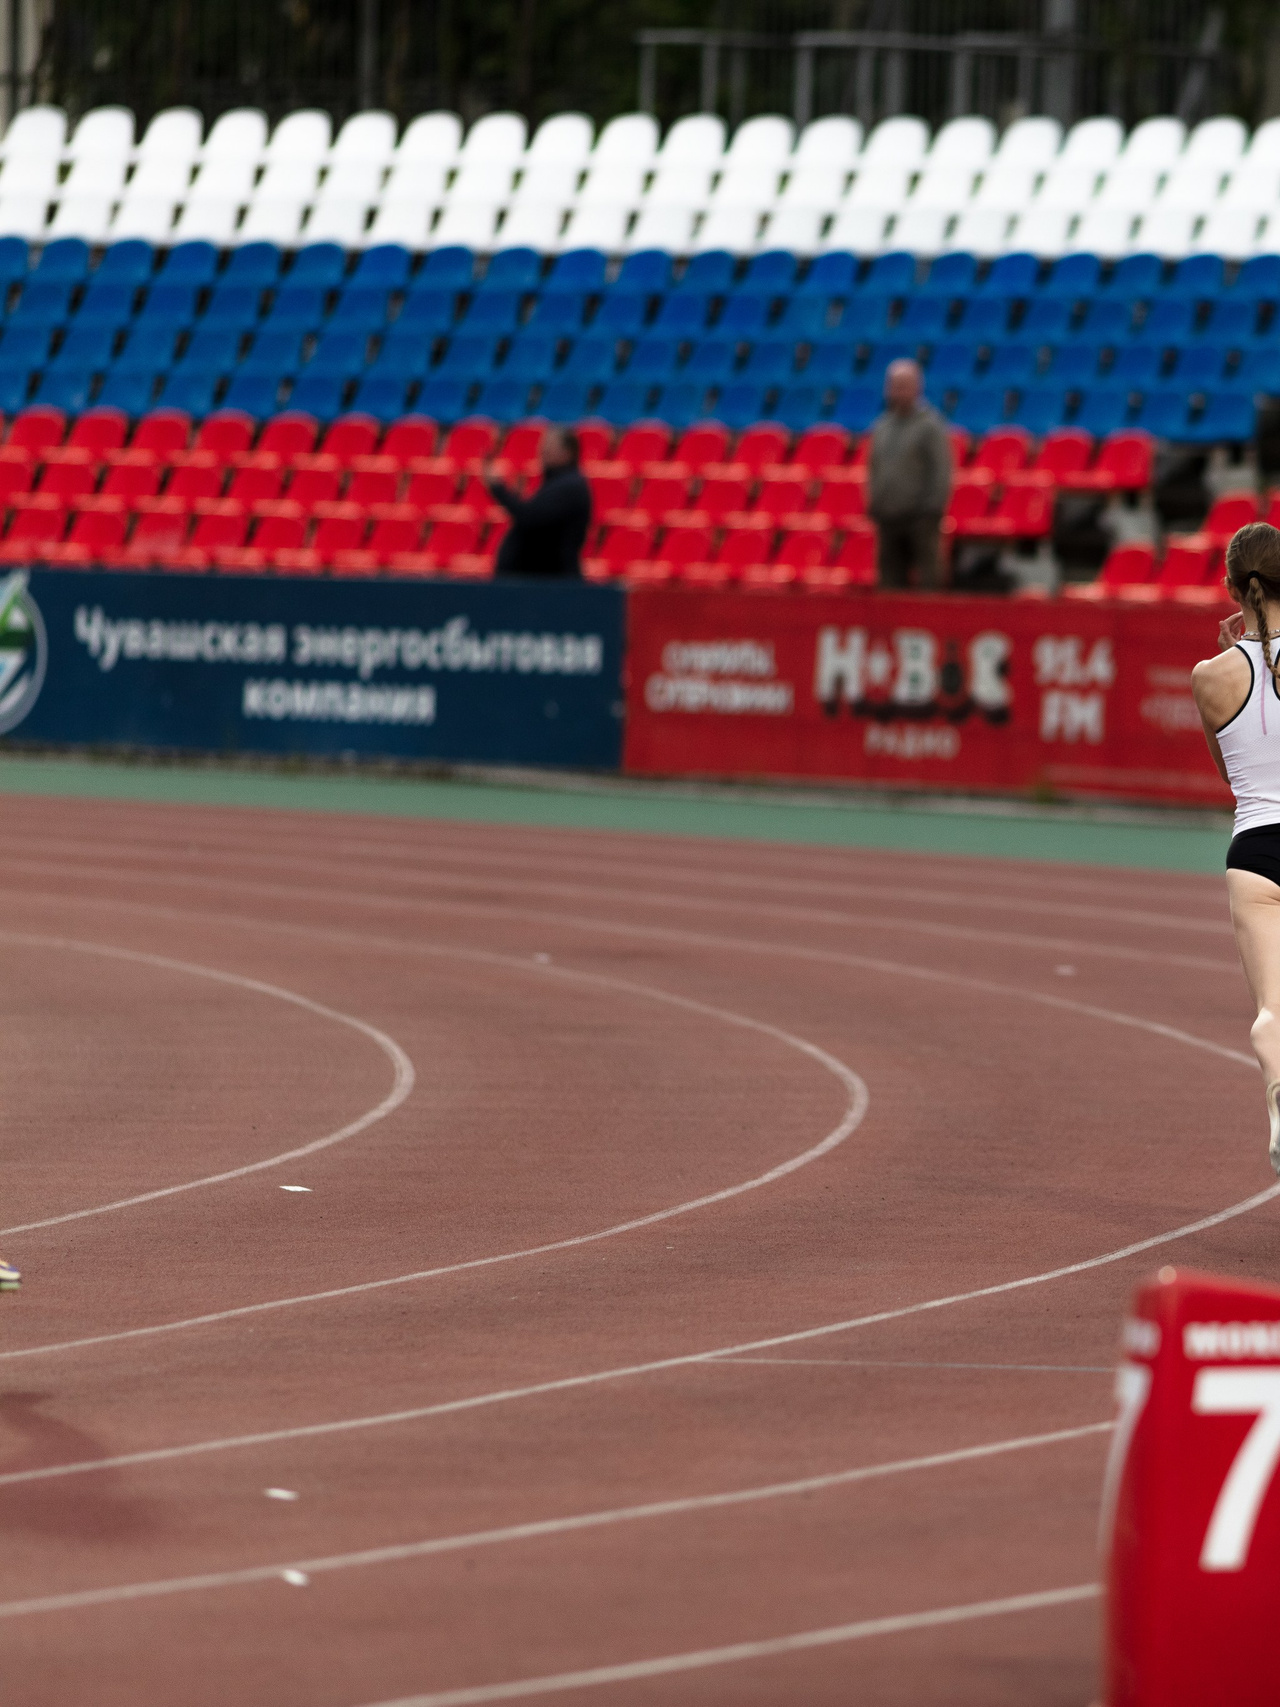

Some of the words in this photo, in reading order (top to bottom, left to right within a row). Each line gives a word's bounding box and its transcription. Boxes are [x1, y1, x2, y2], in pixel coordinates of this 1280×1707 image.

[75, 605, 285, 671] Чувашская
[292, 617, 605, 678] энергосбытовая
[1033, 634, 1115, 688] 95.4
[242, 677, 436, 726] компания
[1040, 689, 1104, 744] FM
